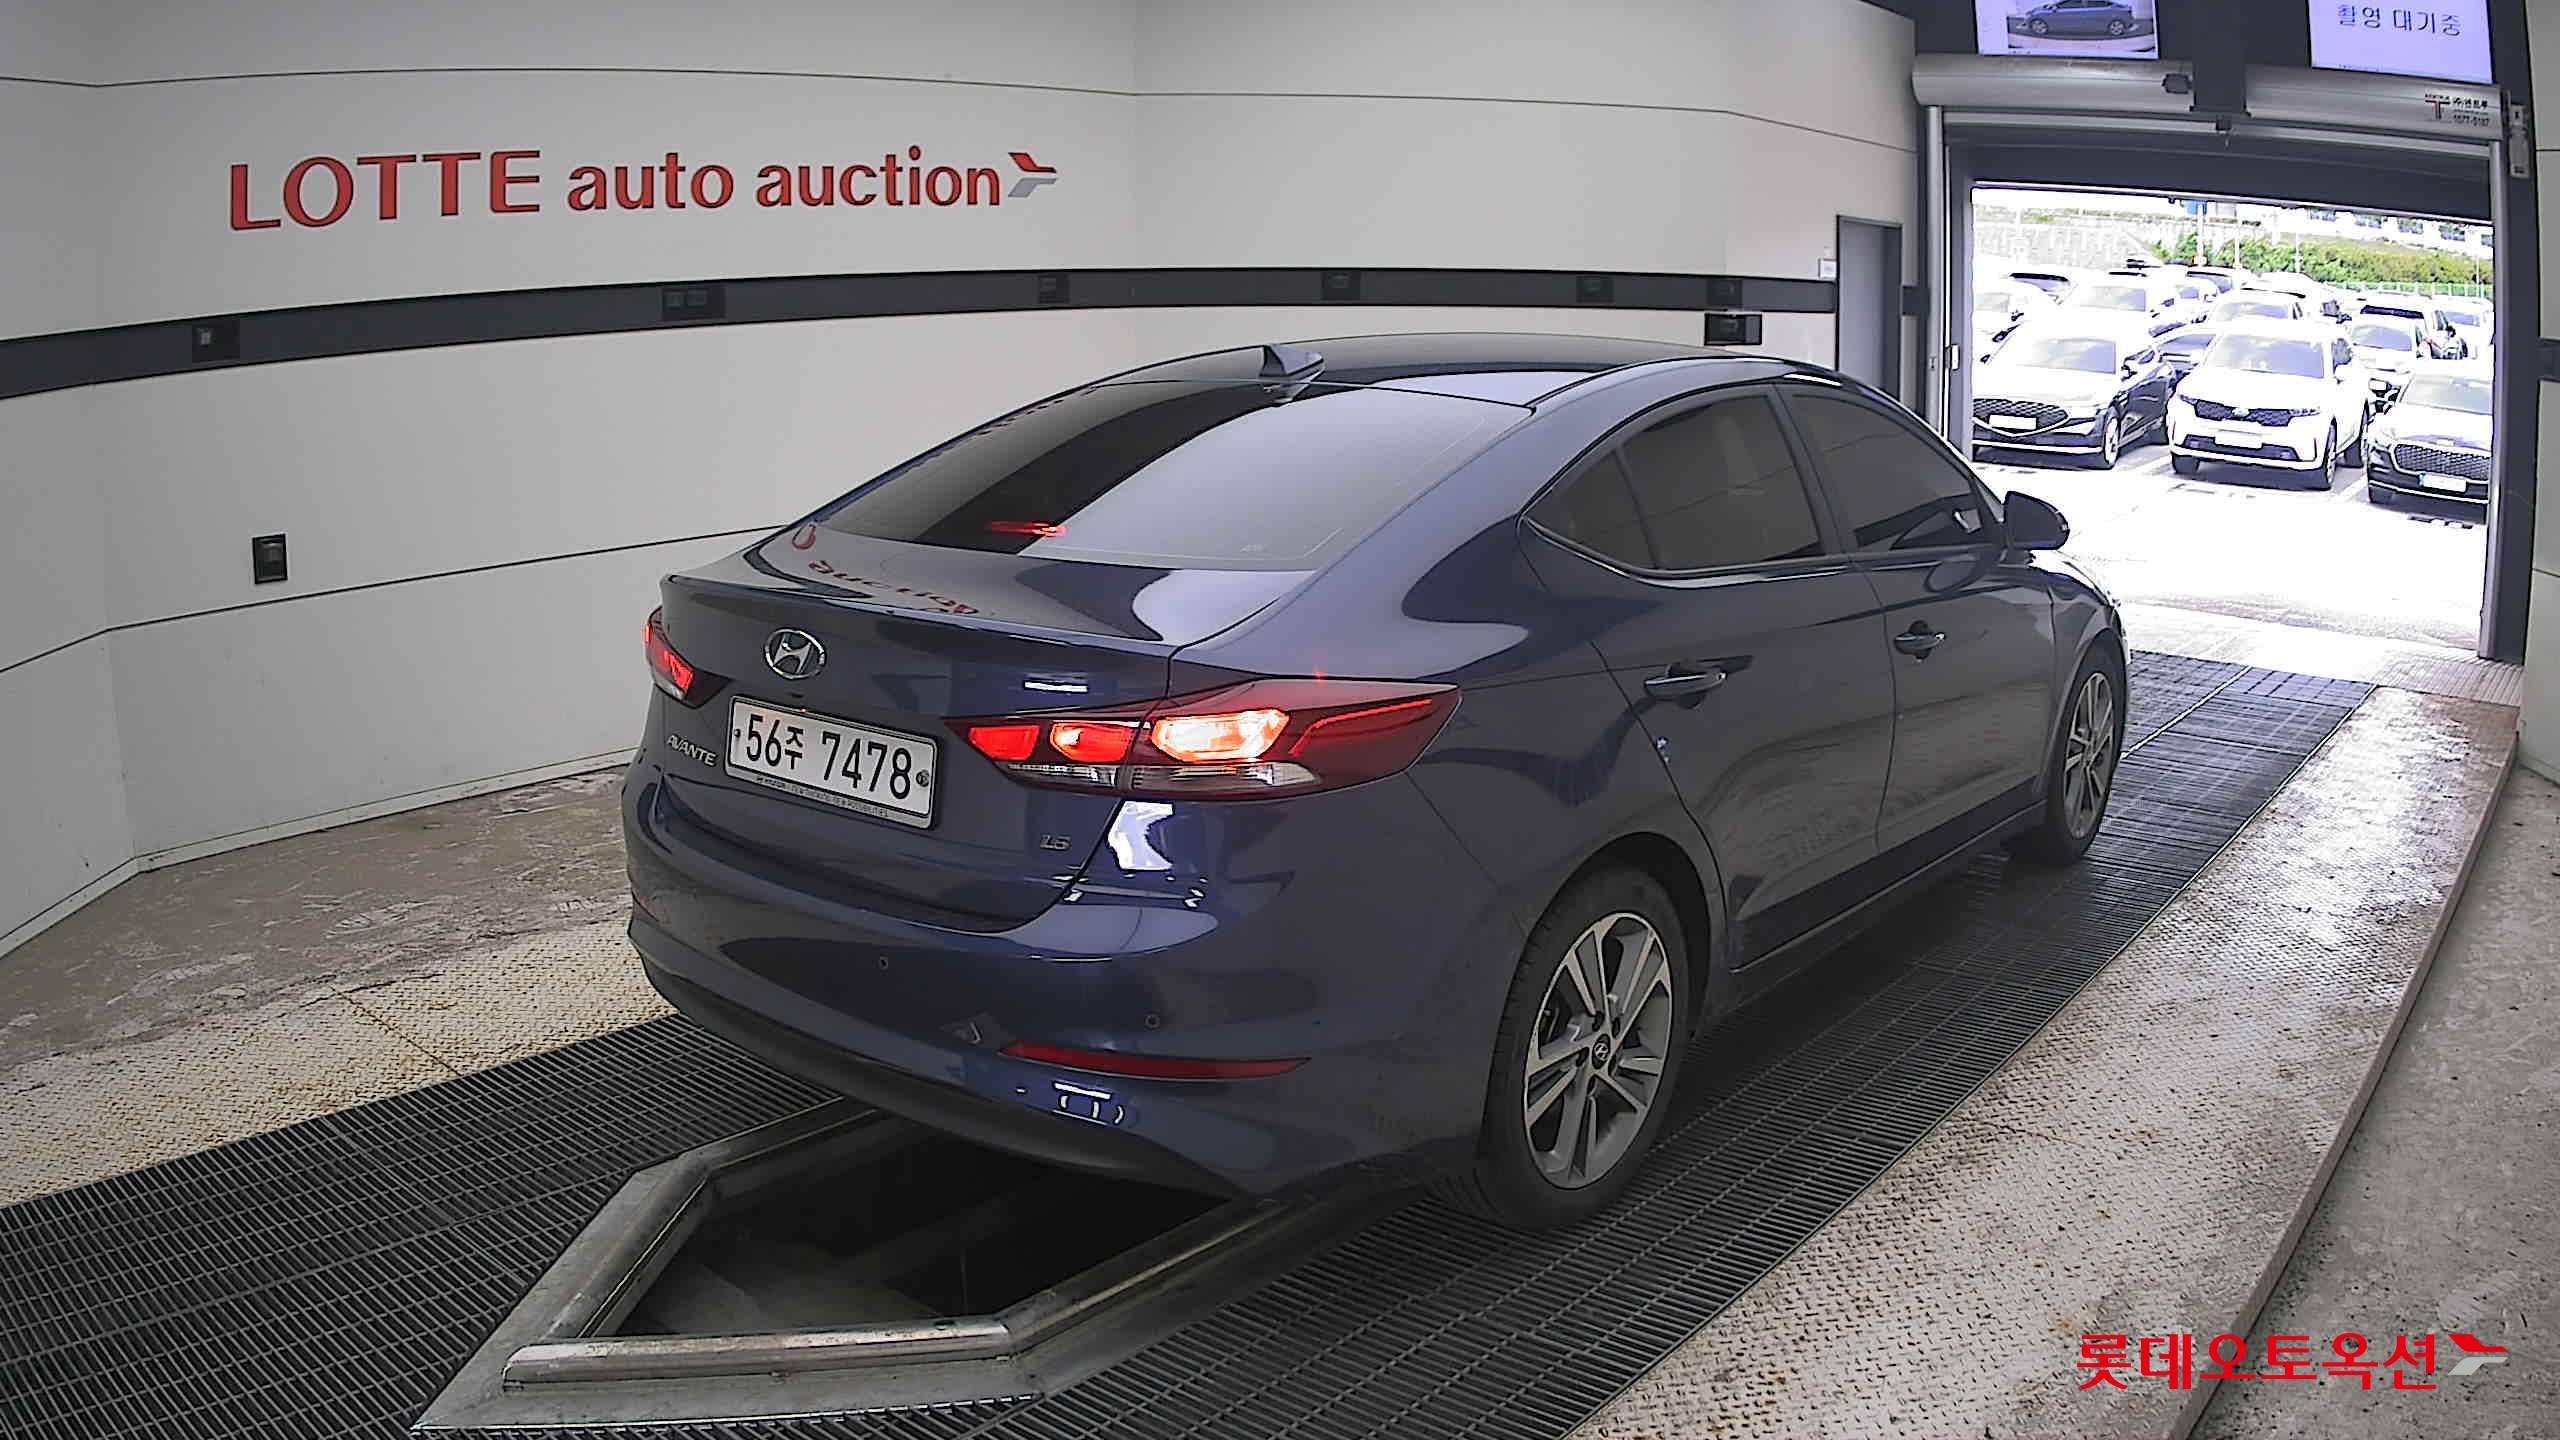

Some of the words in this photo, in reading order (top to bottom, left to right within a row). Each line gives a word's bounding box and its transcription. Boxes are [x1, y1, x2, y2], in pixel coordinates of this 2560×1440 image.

[2337, 4, 2381, 29] 촬영
[2392, 9, 2461, 36] 대기중
[230, 150, 541, 232] LOTTE
[566, 152, 735, 212] auto
[754, 145, 1001, 208] auction
[667, 735, 717, 766] AVANTE
[746, 713, 805, 770] 56주
[821, 732, 912, 800] 7478
